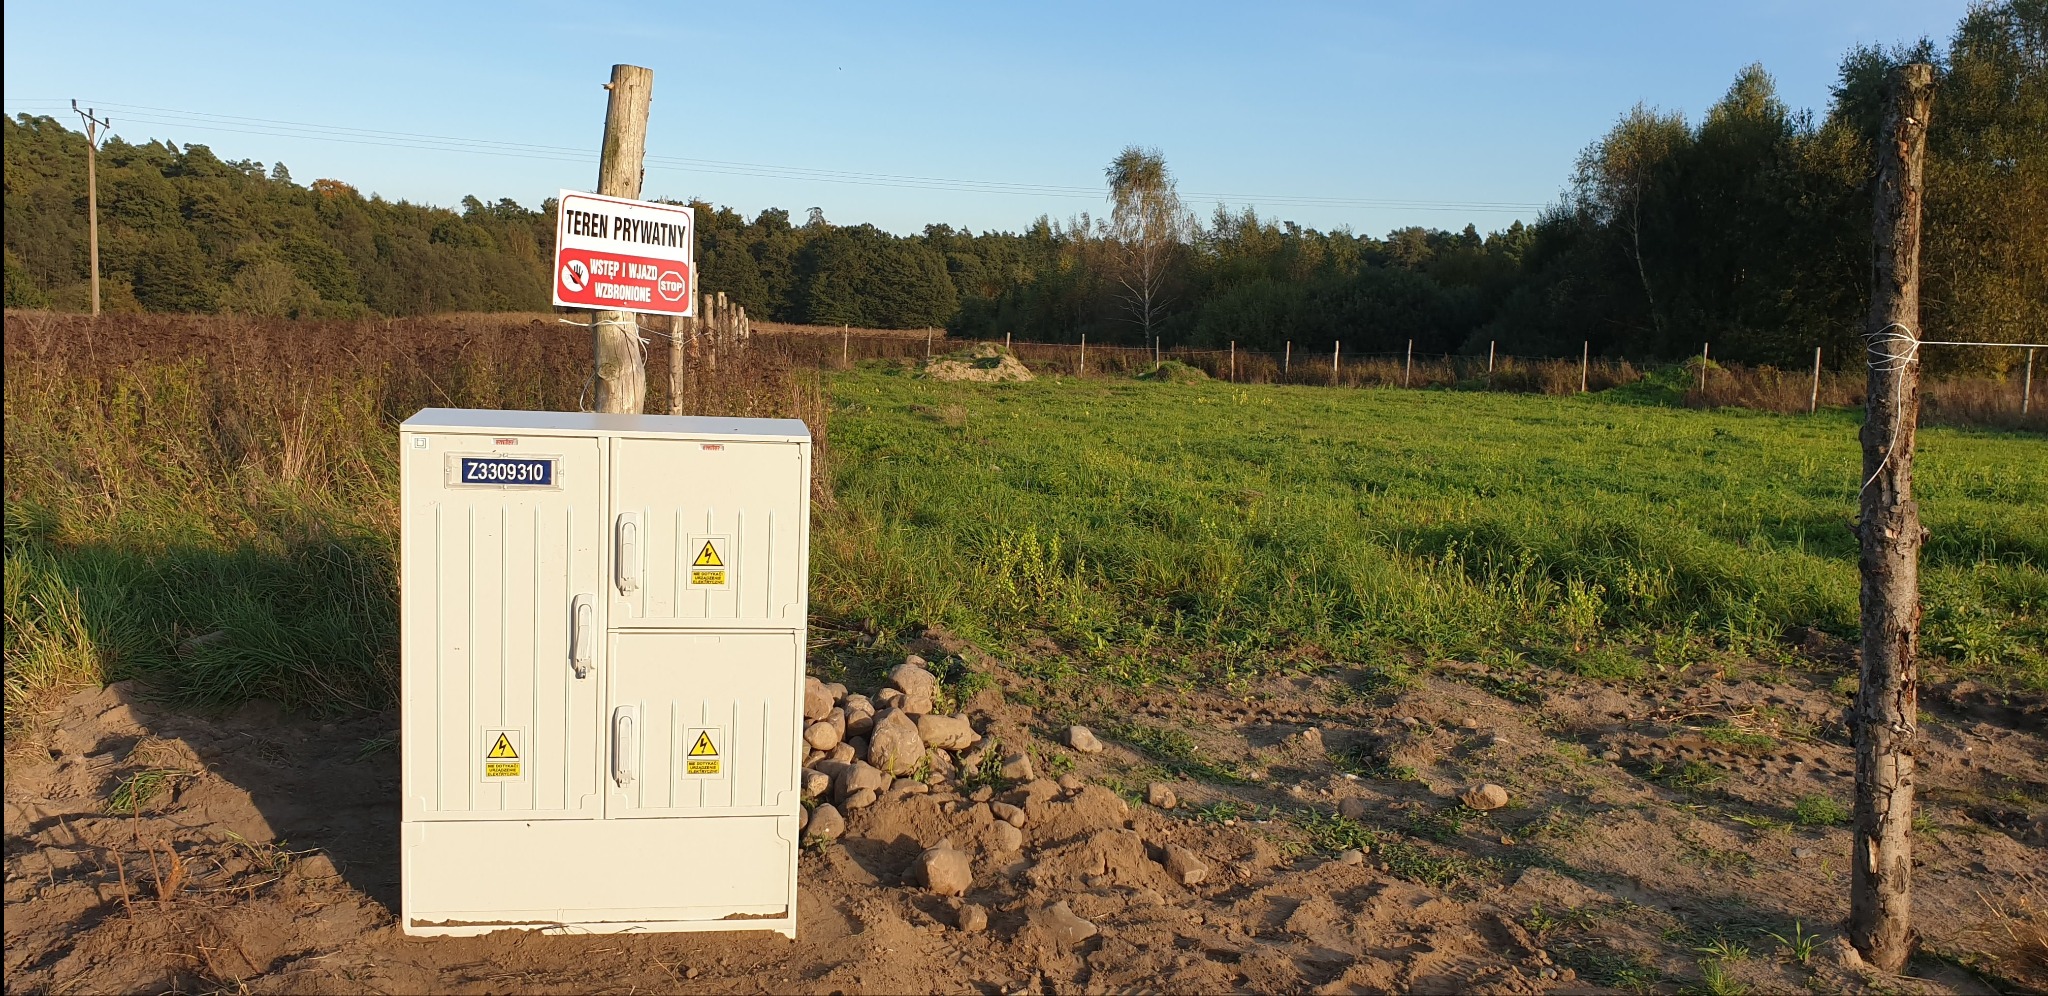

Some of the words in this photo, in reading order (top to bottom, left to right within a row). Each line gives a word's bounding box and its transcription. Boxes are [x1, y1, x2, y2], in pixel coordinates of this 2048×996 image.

[566, 209, 608, 239] TEREN
[613, 216, 686, 249] PRYWATNY
[589, 258, 620, 280] WSTĘP
[621, 262, 626, 278] I
[628, 262, 658, 281] WJAZD
[594, 281, 652, 303] WZBRONIONE
[660, 280, 683, 292] STOP
[467, 462, 544, 481] Z3309310
